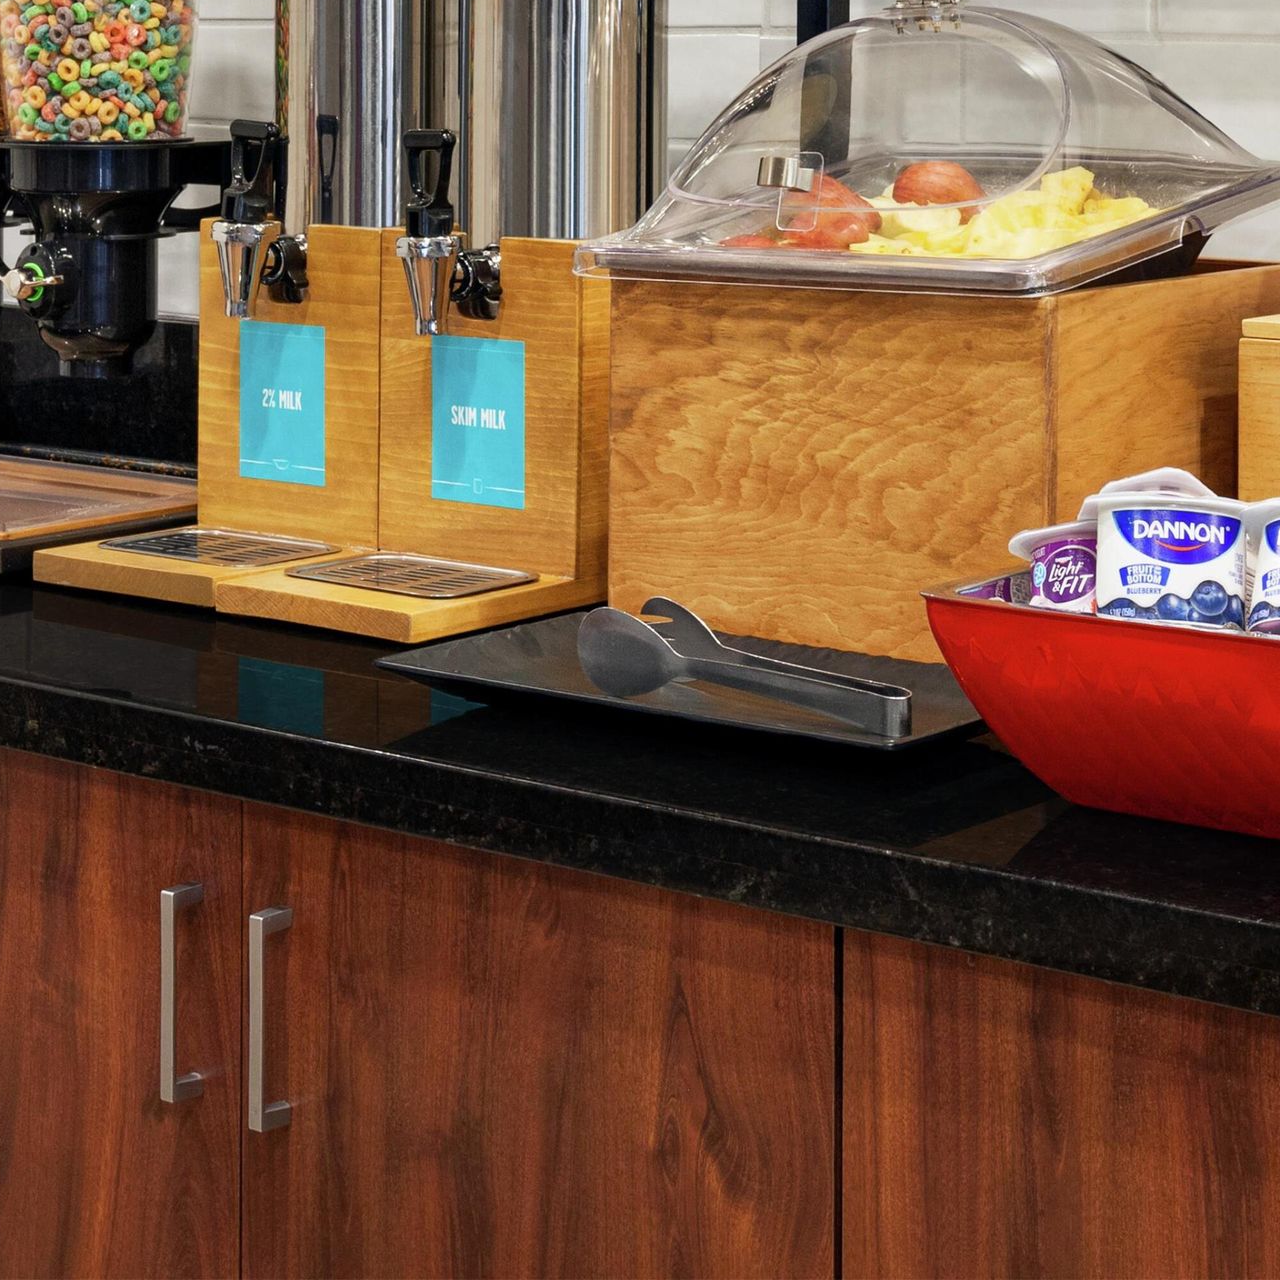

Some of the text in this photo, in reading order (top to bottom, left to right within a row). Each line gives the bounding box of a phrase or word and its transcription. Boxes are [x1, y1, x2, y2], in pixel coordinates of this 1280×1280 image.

[262, 388, 302, 411] 2% MILK
[451, 405, 506, 430] SKIM MILK
[1133, 519, 1225, 545] DANNON
[1049, 561, 1083, 582] Light
[1126, 565, 1154, 576] FRUIT
[1126, 574, 1162, 585] BOTTOM
